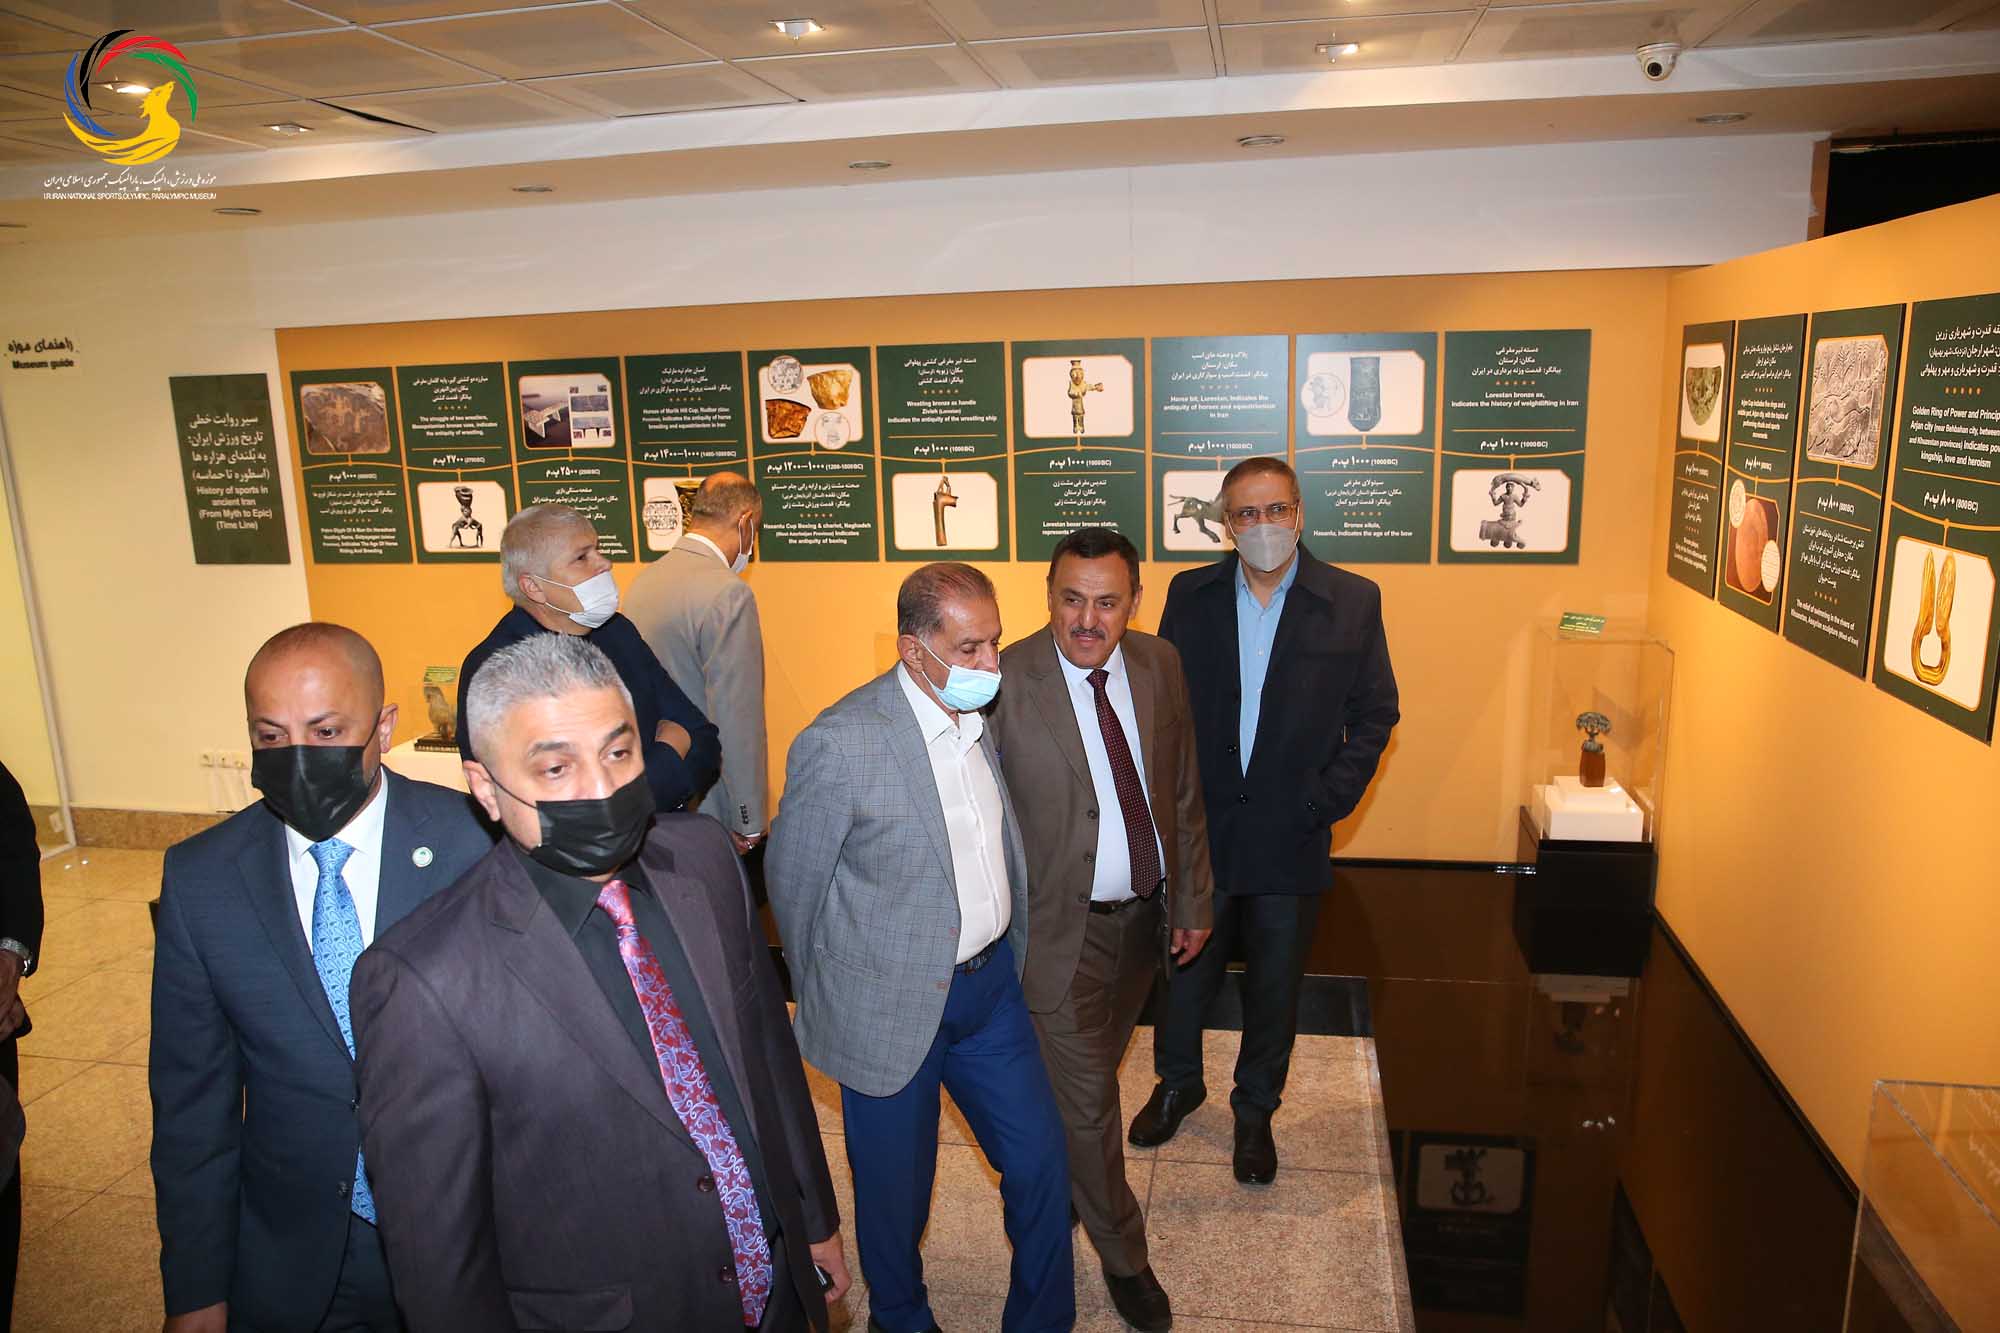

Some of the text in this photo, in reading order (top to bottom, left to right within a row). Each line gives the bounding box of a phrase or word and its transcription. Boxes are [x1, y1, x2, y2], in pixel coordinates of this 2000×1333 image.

[8, 336, 74, 354] راهنمای موزه
[12, 358, 74, 370] Museum guide
[1485, 391, 1512, 399] Lorestan
[1513, 391, 1535, 399] bronze
[1479, 400, 1490, 408] the
[1490, 400, 1513, 409] history
[1520, 400, 1559, 409] weightlifting
[1559, 399, 1566, 407] in
[1566, 399, 1579, 407] Iran
[1912, 405, 1930, 416] Golden
[1930, 406, 1943, 419] Ring
[1943, 407, 1950, 417] of
[1950, 407, 1967, 418] Power
[1967, 408, 1980, 419] and
[189, 413, 259, 429] سیر روایت خطی
[1924, 421, 1934, 433] city
[214, 432, 240, 447] ورزش
[240, 431, 264, 446] تاریخ
[1963, 440, 1990, 452] Indicates
[1920, 450, 1991, 468] kingship, love and heroism
[196, 484, 269, 497] History of sports in
[240, 497, 257, 506] Iran
[199, 508, 273, 520] (From Myth to Epic)
[216, 520, 259, 531] (Time Line)
